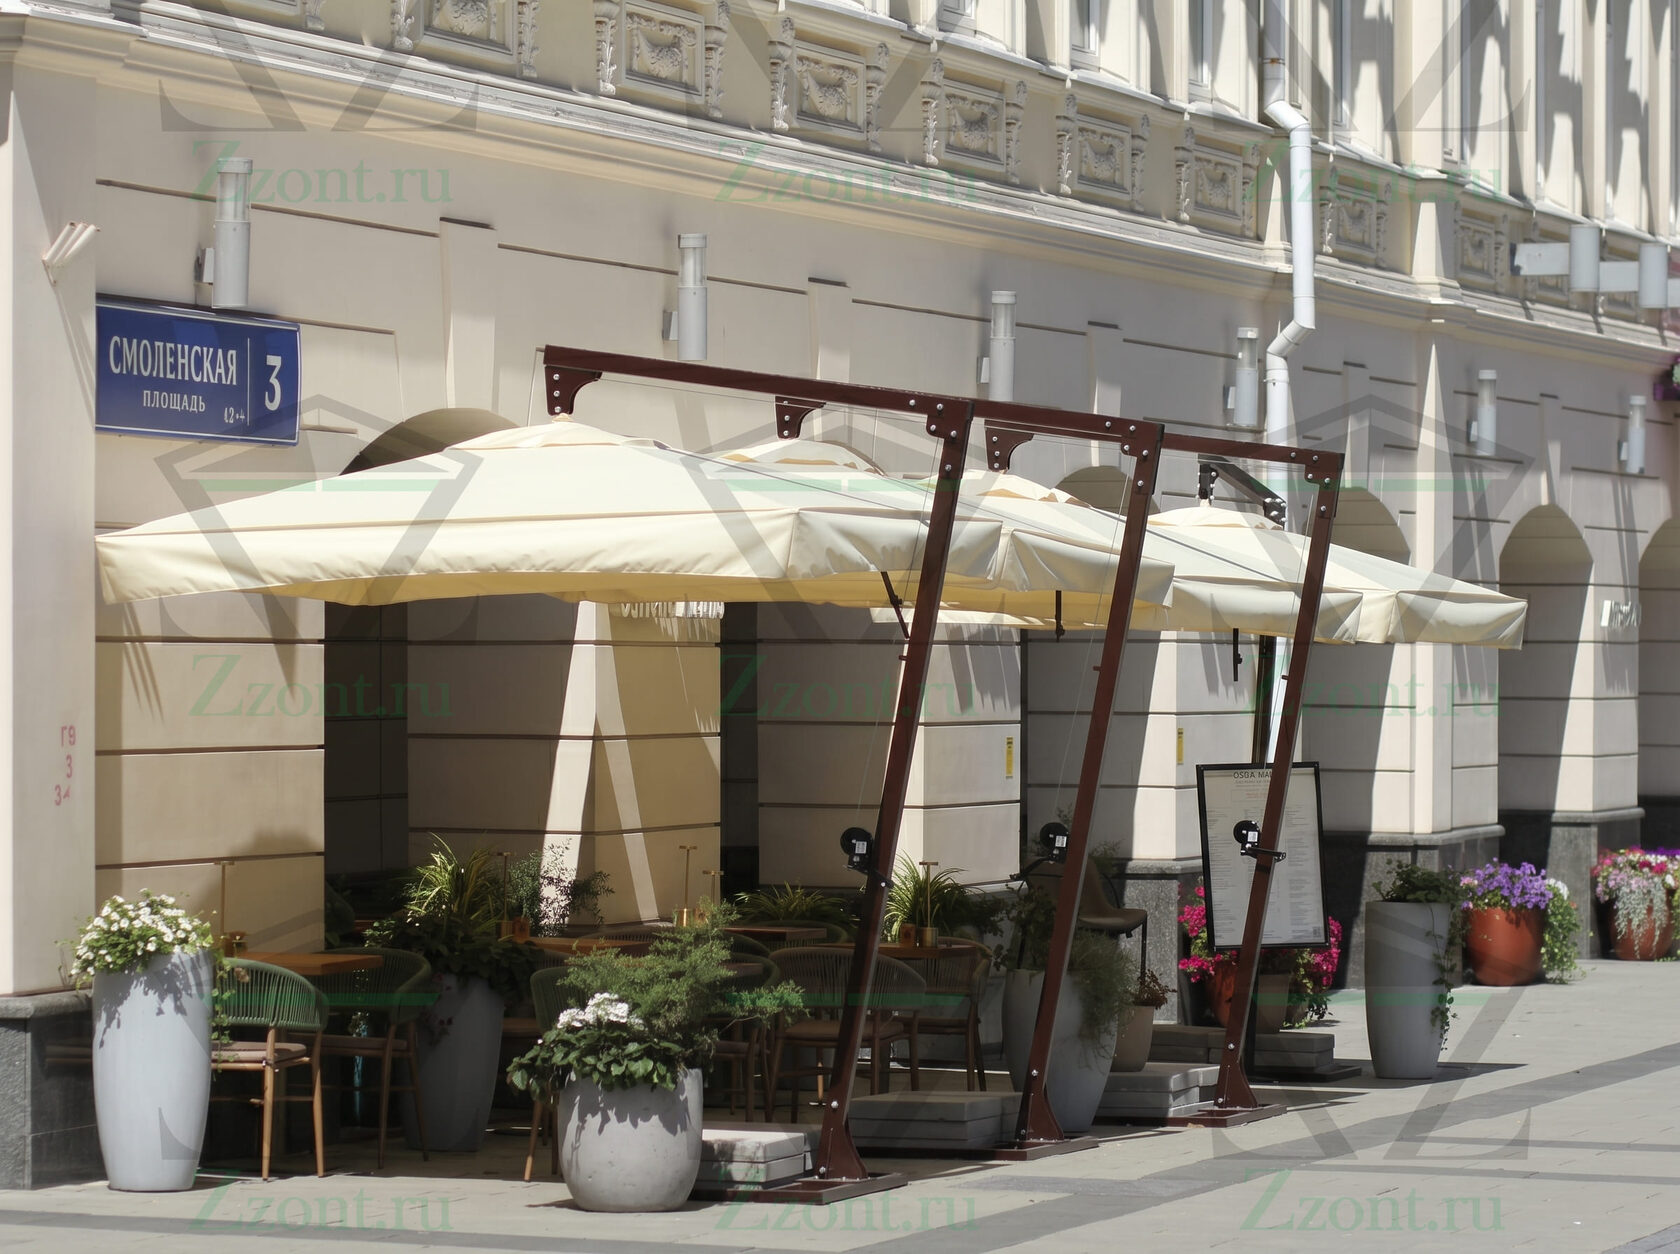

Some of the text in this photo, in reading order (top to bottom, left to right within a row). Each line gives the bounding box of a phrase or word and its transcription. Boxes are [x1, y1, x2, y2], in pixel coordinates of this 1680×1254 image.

[109, 335, 237, 385] СМОЛЕНСКАЯ
[264, 354, 282, 411] 3
[143, 390, 206, 413] ПЛОЩАДЬ
